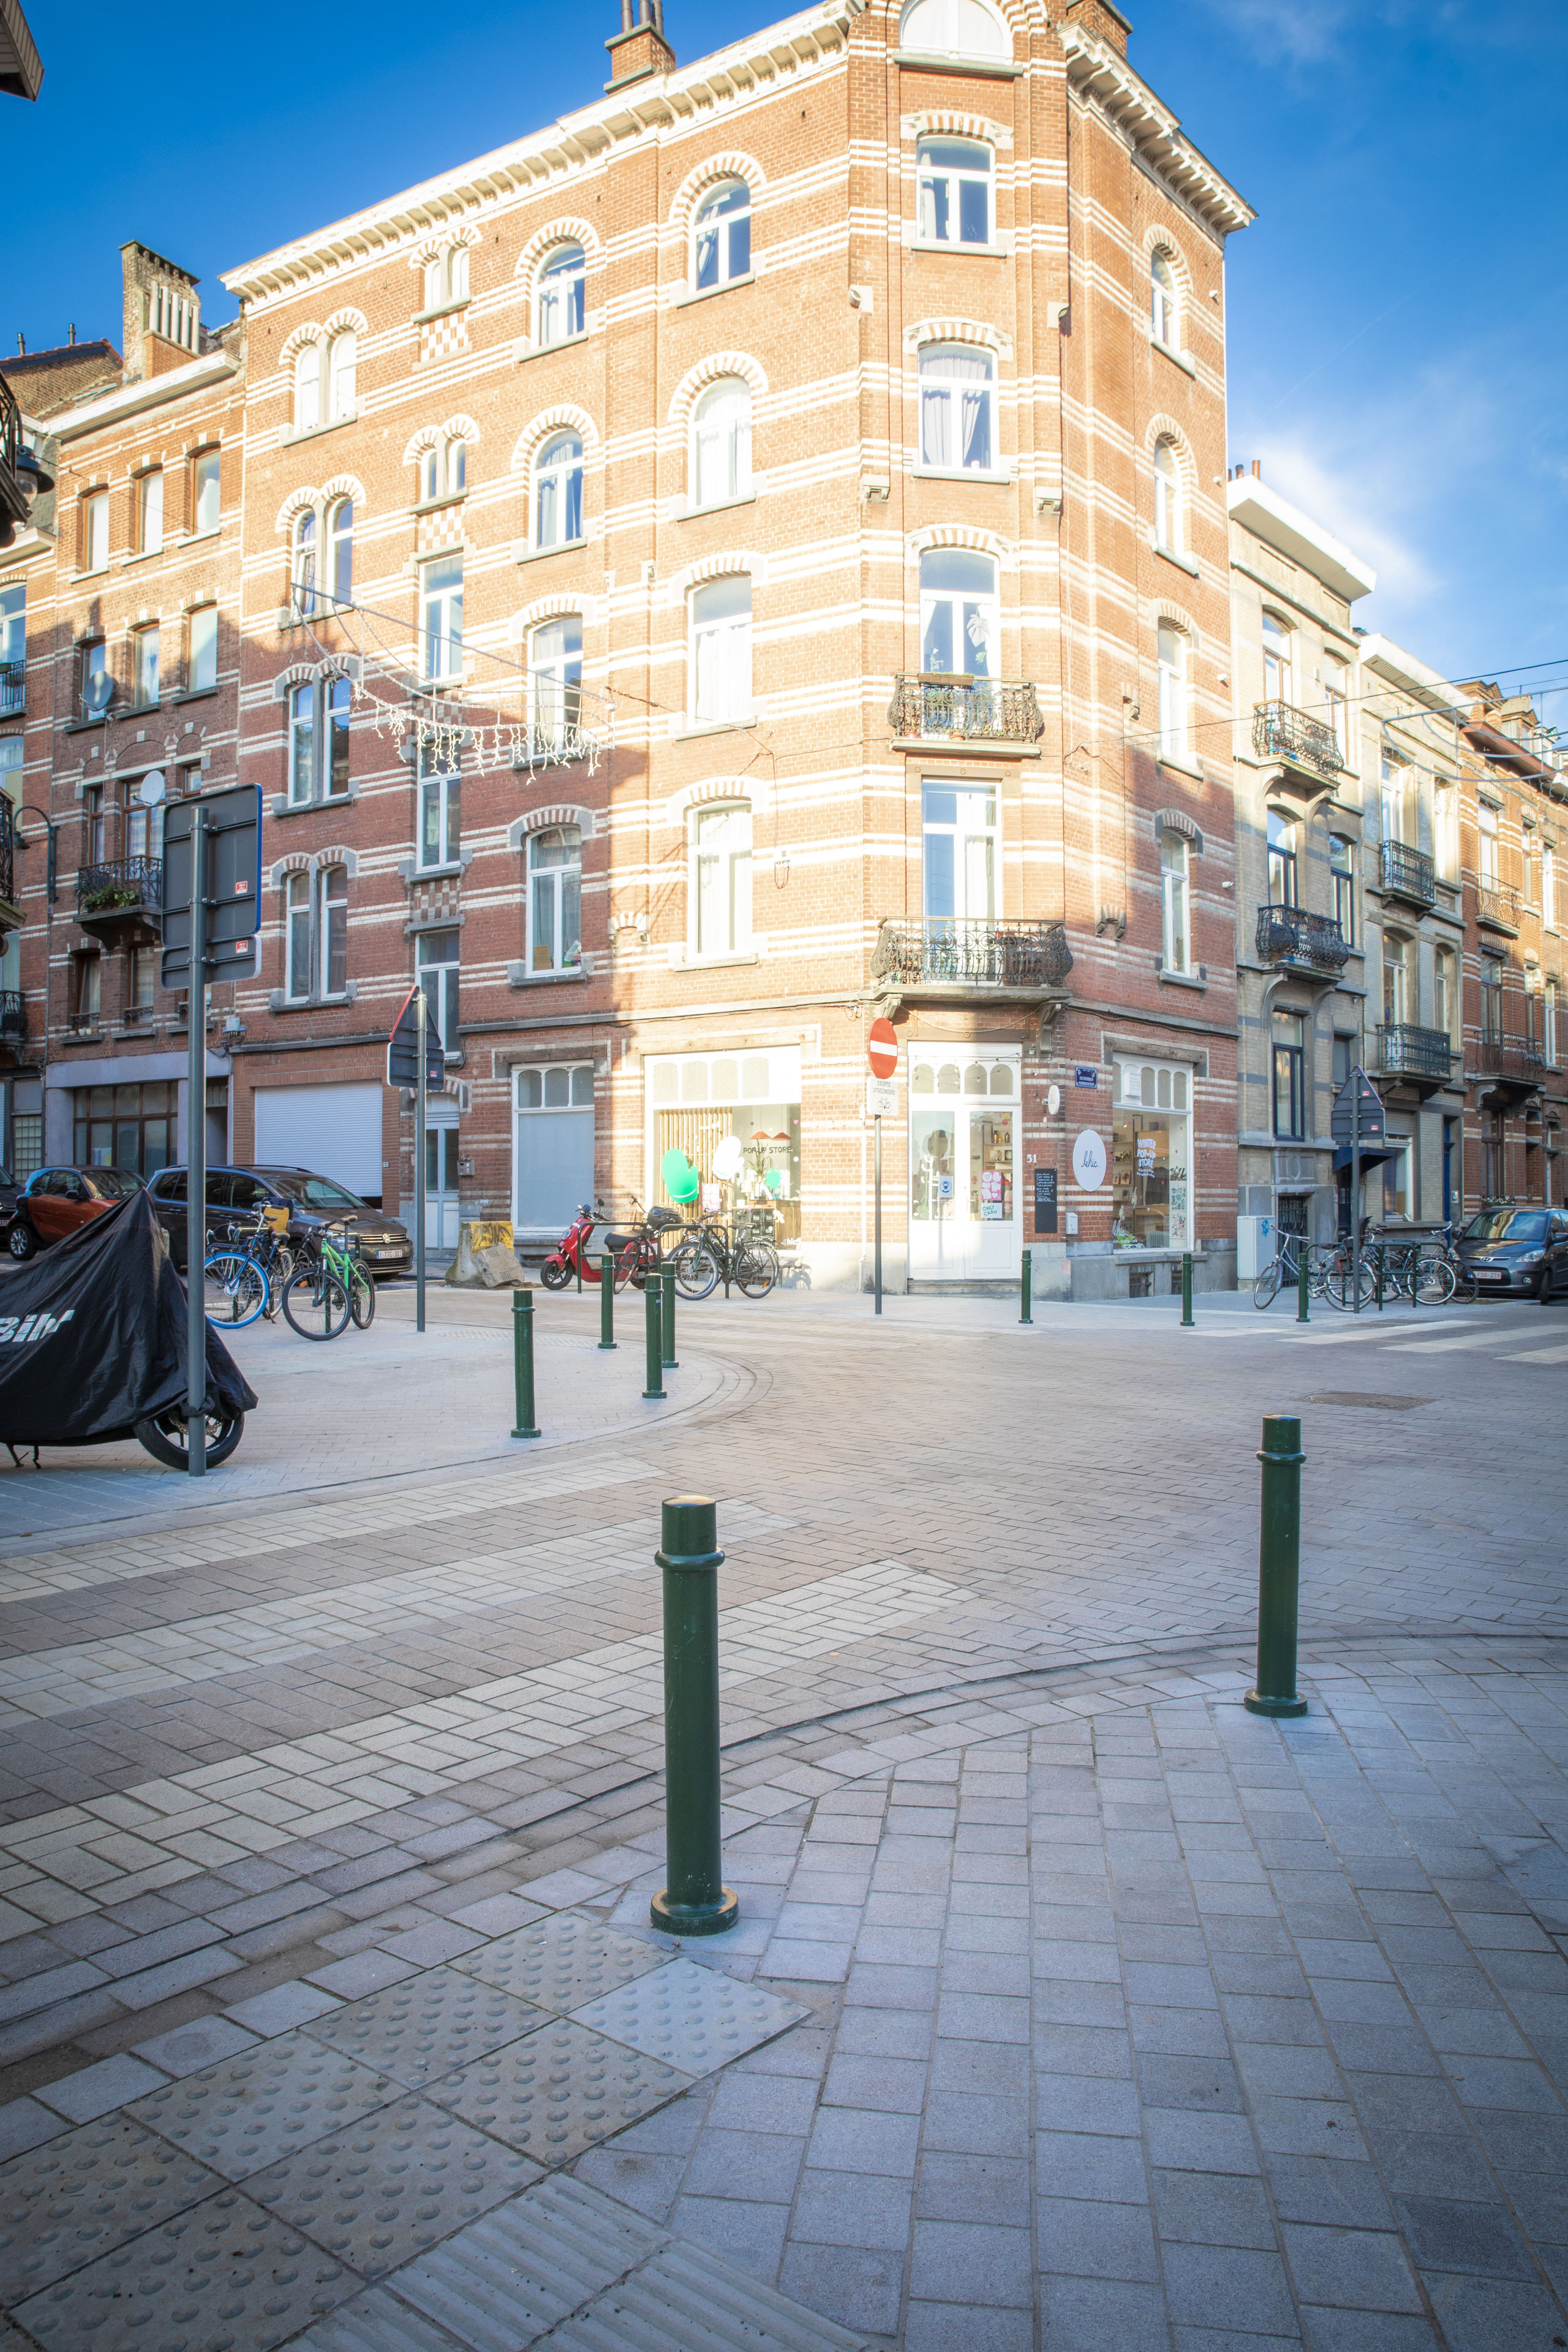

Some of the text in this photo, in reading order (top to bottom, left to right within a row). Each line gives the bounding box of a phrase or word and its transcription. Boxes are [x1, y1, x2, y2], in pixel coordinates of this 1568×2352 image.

[1137, 1138, 1156, 1150] WINTER
[1027, 1154, 1036, 1163] 51
[1137, 1148, 1156, 1159] POP-UP
[1138, 1158, 1154, 1168] STORE
